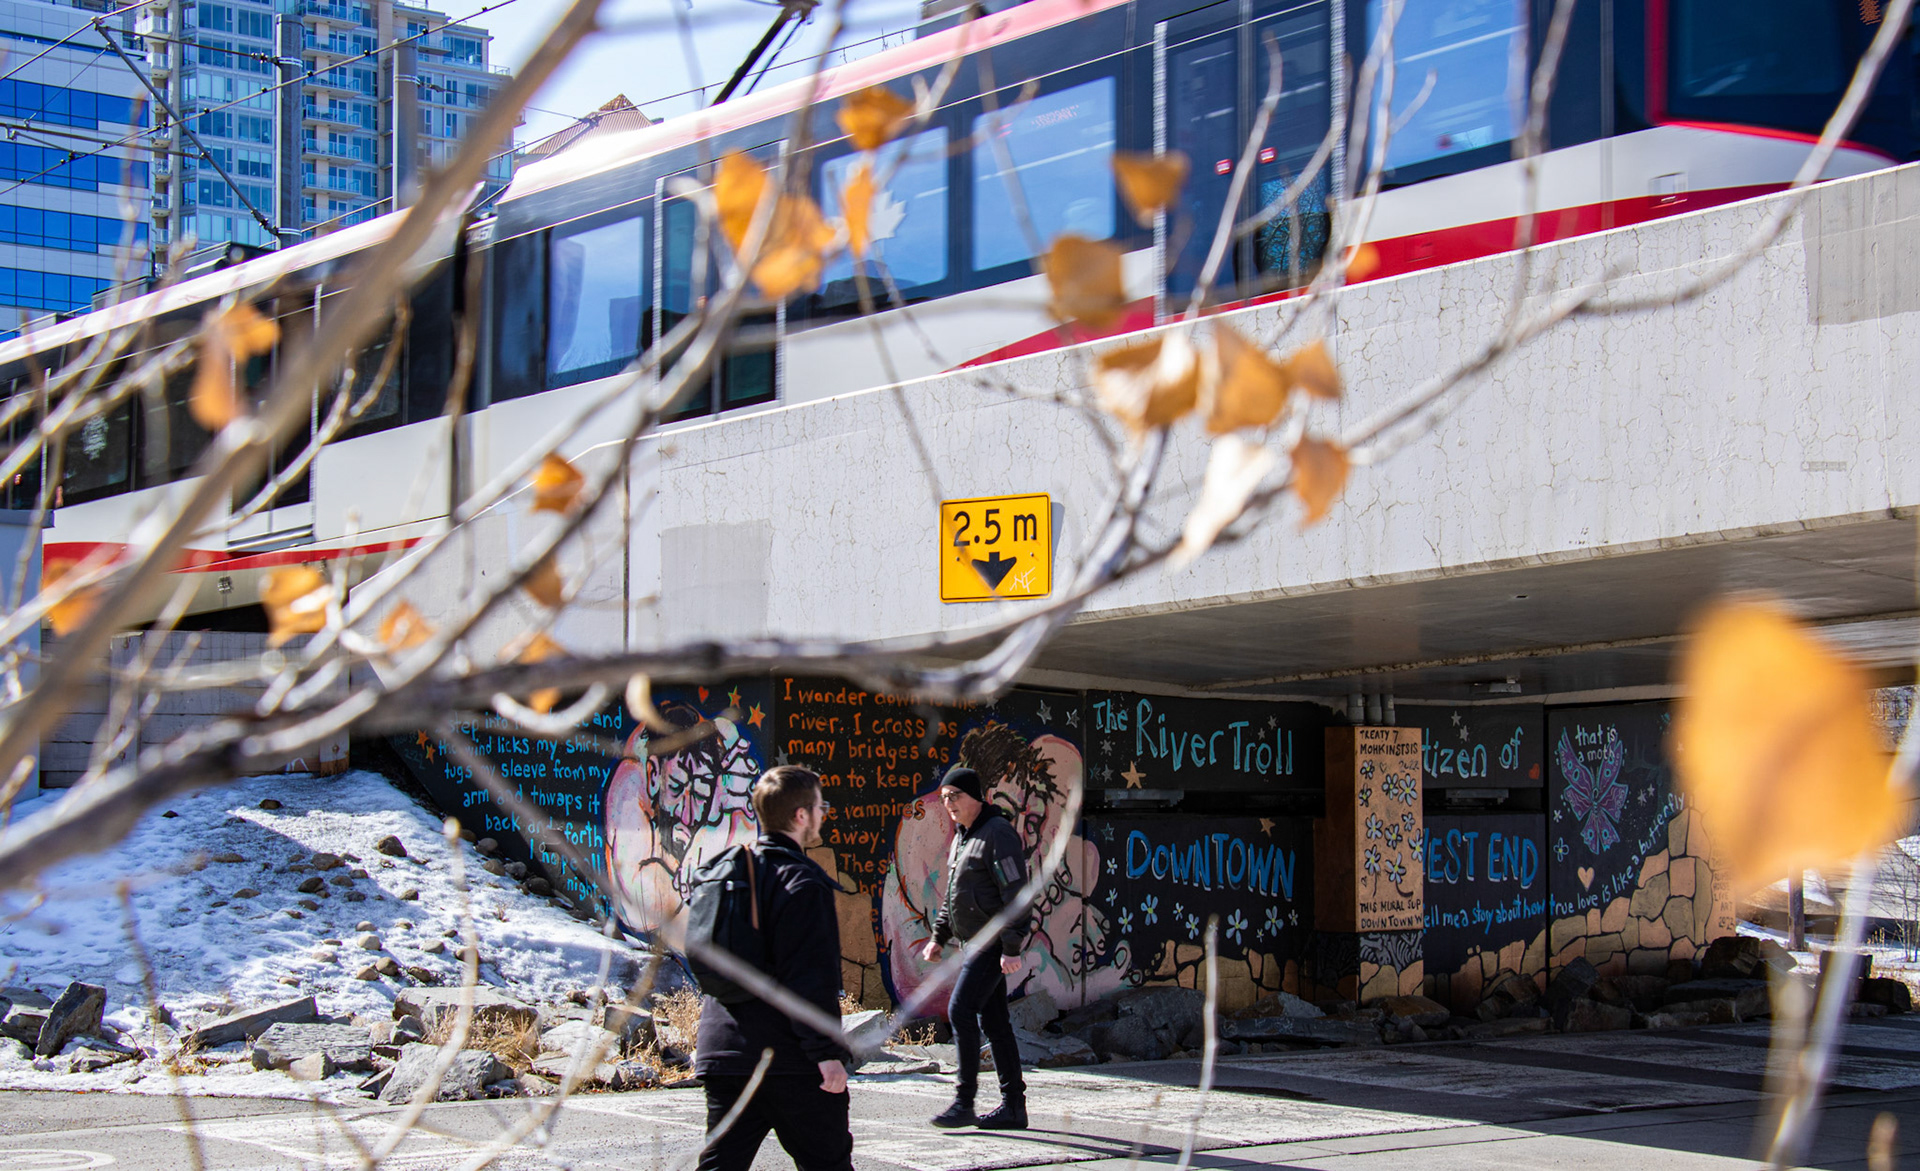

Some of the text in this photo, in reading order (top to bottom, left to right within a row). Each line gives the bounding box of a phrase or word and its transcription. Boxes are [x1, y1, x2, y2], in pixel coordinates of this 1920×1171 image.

[953, 508, 1037, 546] 2.5 m
[784, 678, 793, 701] I
[798, 687, 866, 705] wander
[593, 706, 622, 730] and
[789, 713, 958, 739] river. I cross as
[498, 735, 530, 755] licks
[537, 739, 557, 760] my
[1093, 699, 1293, 775] The River Troll
[1360, 730, 1399, 743] TREATY 7
[1360, 742, 1418, 756] MOHKINSTSIS
[1575, 724, 1617, 746] that is
[788, 738, 950, 770] many bridges as
[1422, 726, 1523, 778] tizen of
[1578, 744, 1615, 762] a moth
[444, 762, 474, 784] tugs
[501, 758, 546, 778] sleeve
[553, 759, 585, 780] from
[588, 765, 610, 788] my
[819, 765, 922, 795] an to keep
[463, 789, 489, 807] arm
[589, 793, 601, 815] it
[845, 798, 926, 828] vampires
[485, 811, 520, 832] back
[564, 821, 602, 848] forth
[829, 828, 886, 854] away.
[1126, 830, 1296, 902] DOWNTOWN
[1423, 904, 1440, 934] ell
[1472, 900, 1493, 935] story
[1496, 894, 1521, 923] about
[1523, 898, 1545, 919] how
[1549, 893, 1575, 916] true
[1577, 893, 1598, 911] love
[1601, 884, 1611, 903] is
[1612, 865, 1634, 894] like
[1632, 854, 1640, 865] a
[1638, 792, 1685, 855] butterfly
[1488, 832, 1539, 889] END
[1360, 902, 1378, 913] THIS
[1380, 900, 1404, 912] MURAL
